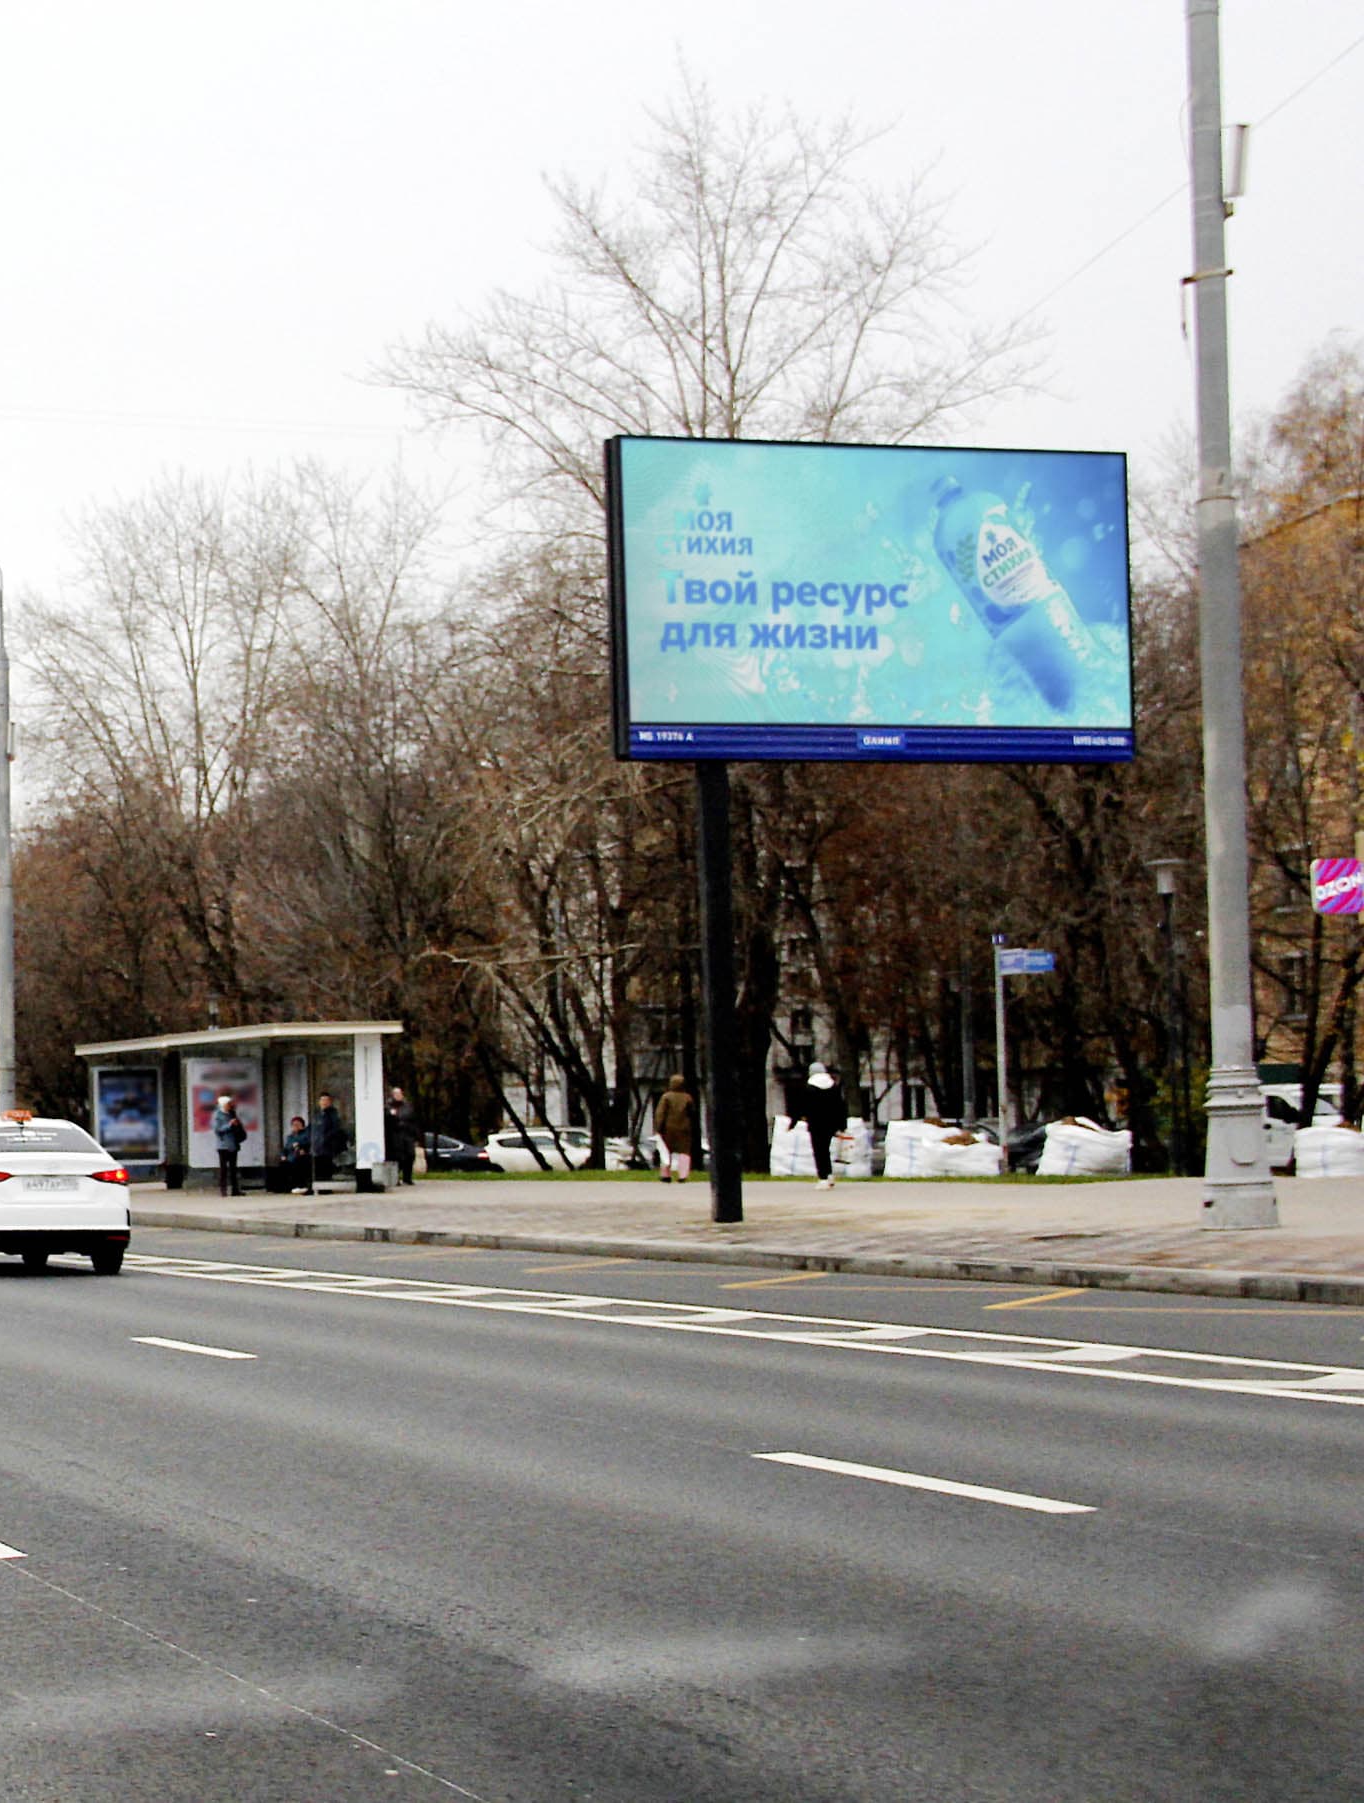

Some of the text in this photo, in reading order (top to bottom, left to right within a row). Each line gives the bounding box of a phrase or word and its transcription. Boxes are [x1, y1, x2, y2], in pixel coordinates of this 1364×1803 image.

[657, 569, 909, 616] Твой ресурс
[659, 621, 880, 653] для жизни
[1315, 871, 1364, 901] OZON
